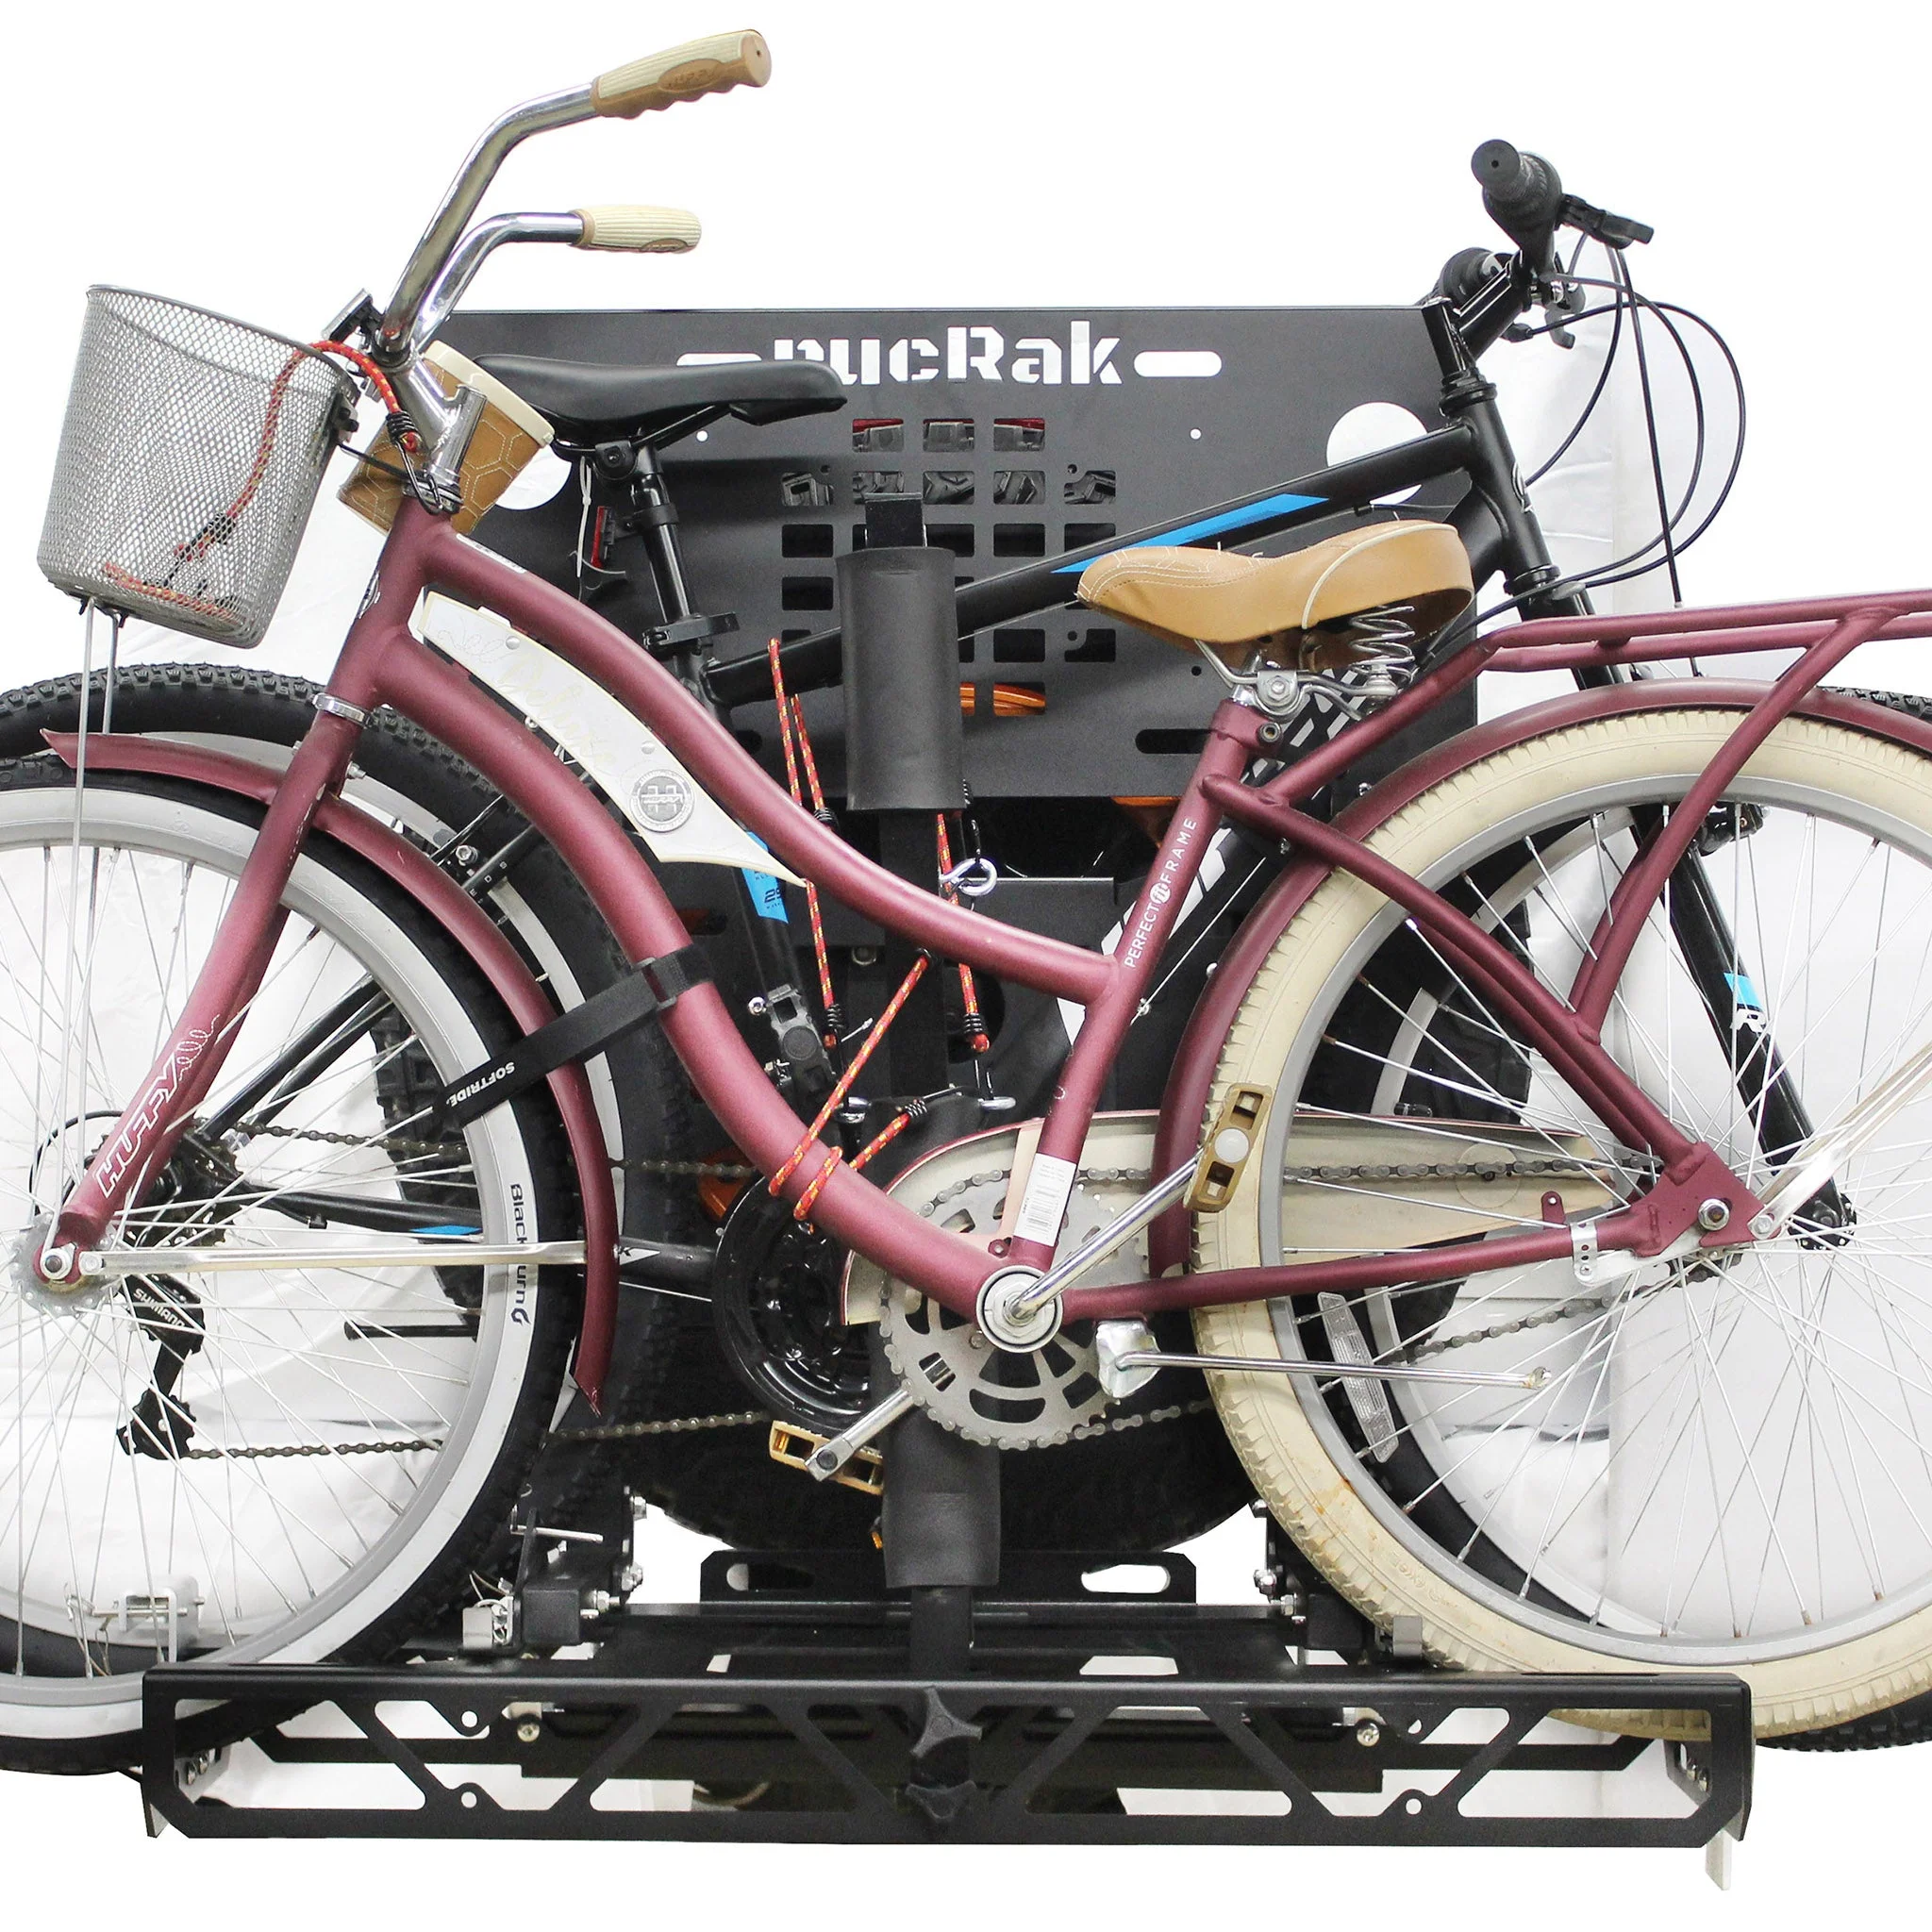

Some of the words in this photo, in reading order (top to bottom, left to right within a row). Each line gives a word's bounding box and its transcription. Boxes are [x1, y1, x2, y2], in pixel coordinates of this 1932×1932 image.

[1124, 901, 1160, 968] PERFECT
[1160, 817, 1197, 884] FRAME
[94, 1052, 178, 1199] HUFFY
[448, 1061, 516, 1107] SOFTRIDE
[510, 1183, 528, 1304] Blackurn
